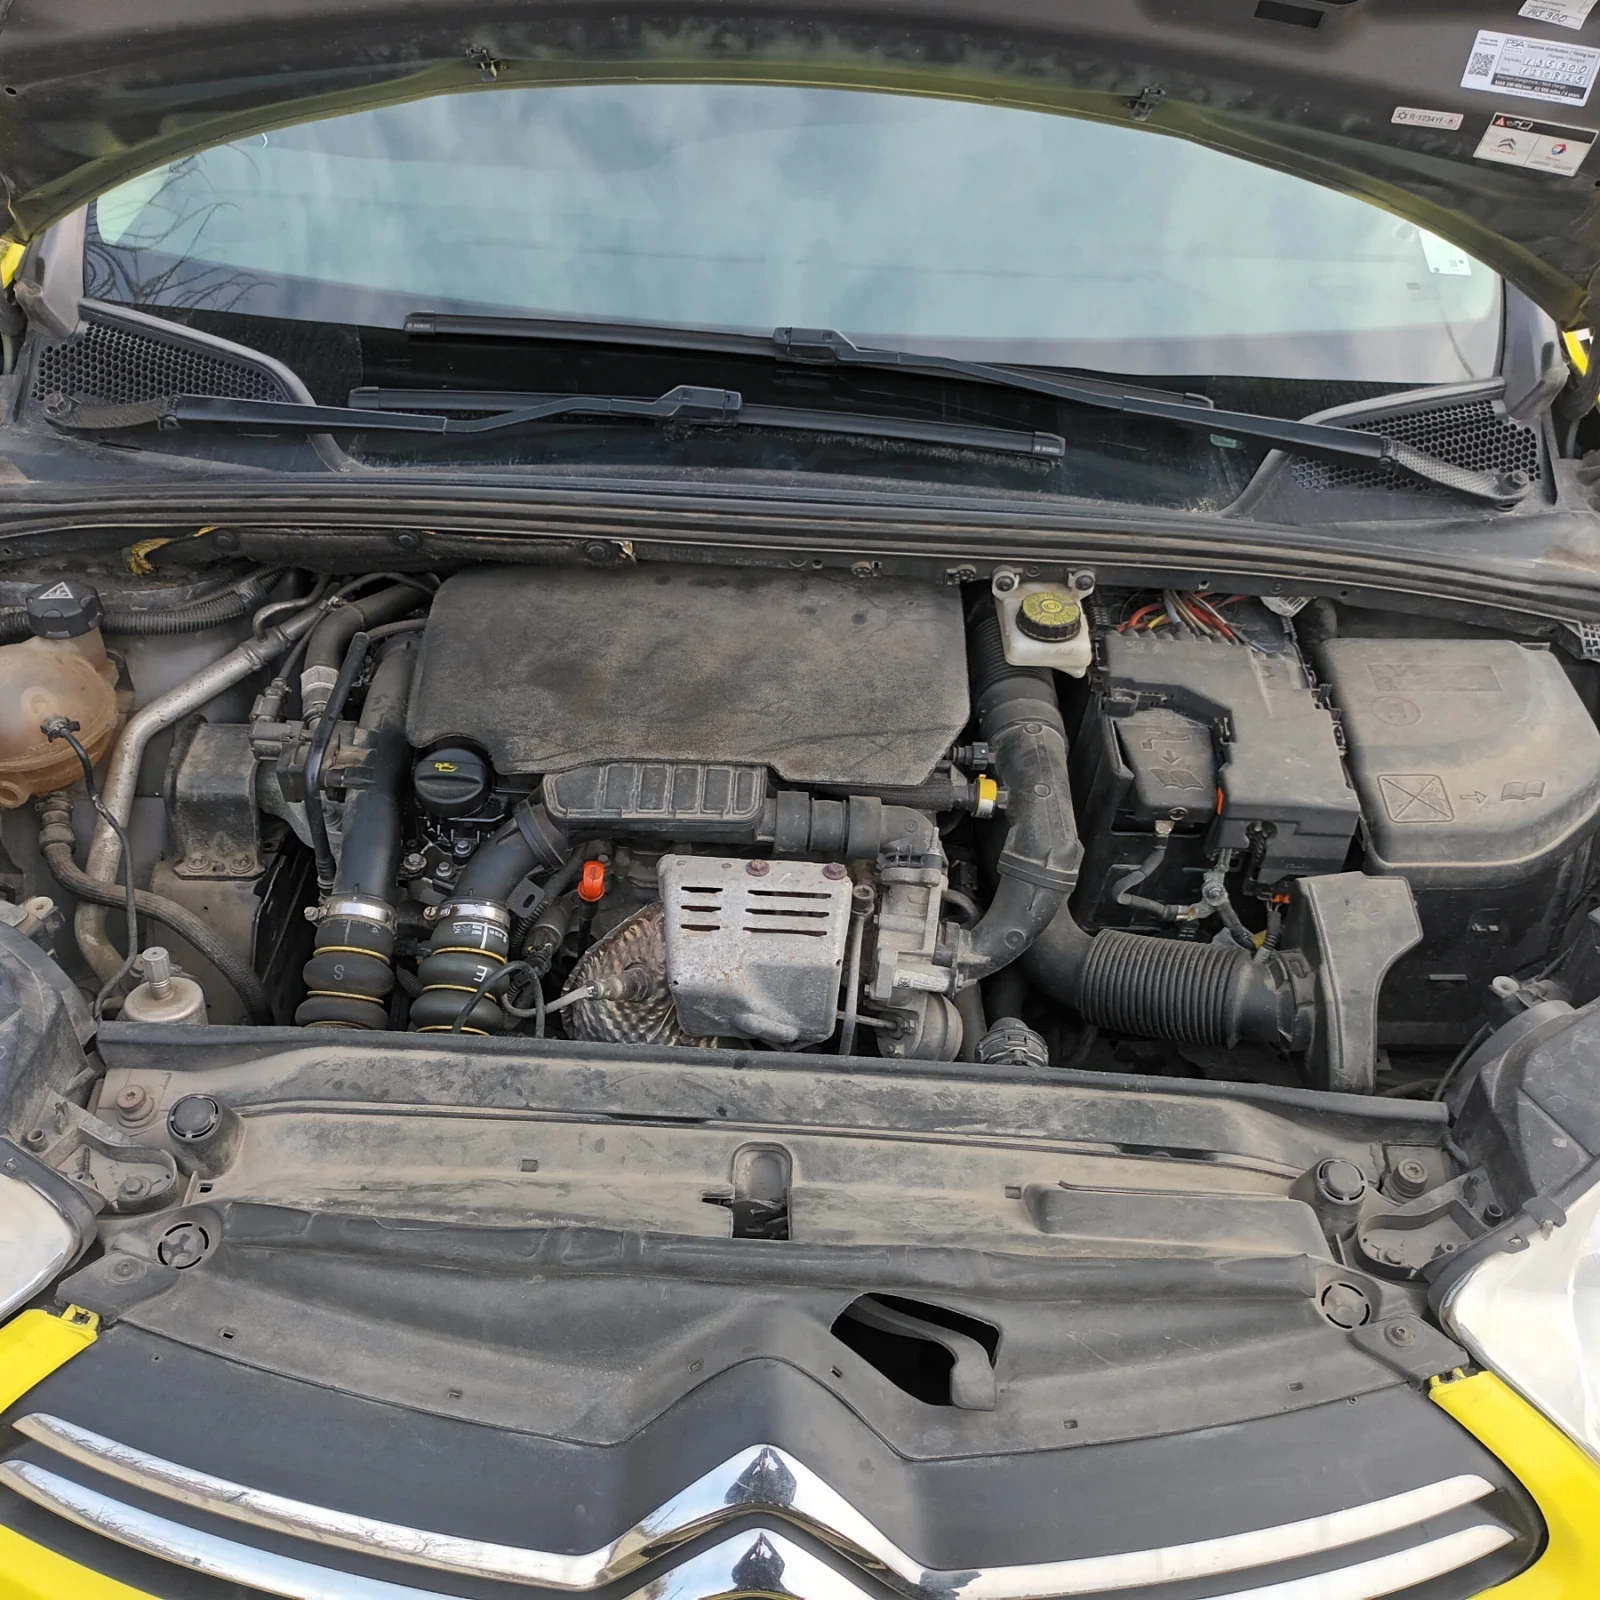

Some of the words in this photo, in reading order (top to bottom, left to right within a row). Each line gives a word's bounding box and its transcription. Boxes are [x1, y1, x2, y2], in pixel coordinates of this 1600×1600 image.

[1545, 12, 1567, 22] 900
[1506, 39, 1524, 48] PSA
[1545, 46, 1568, 54] distribution
[1408, 113, 1444, 124] R-1234YF
[333, 965, 344, 980] S
